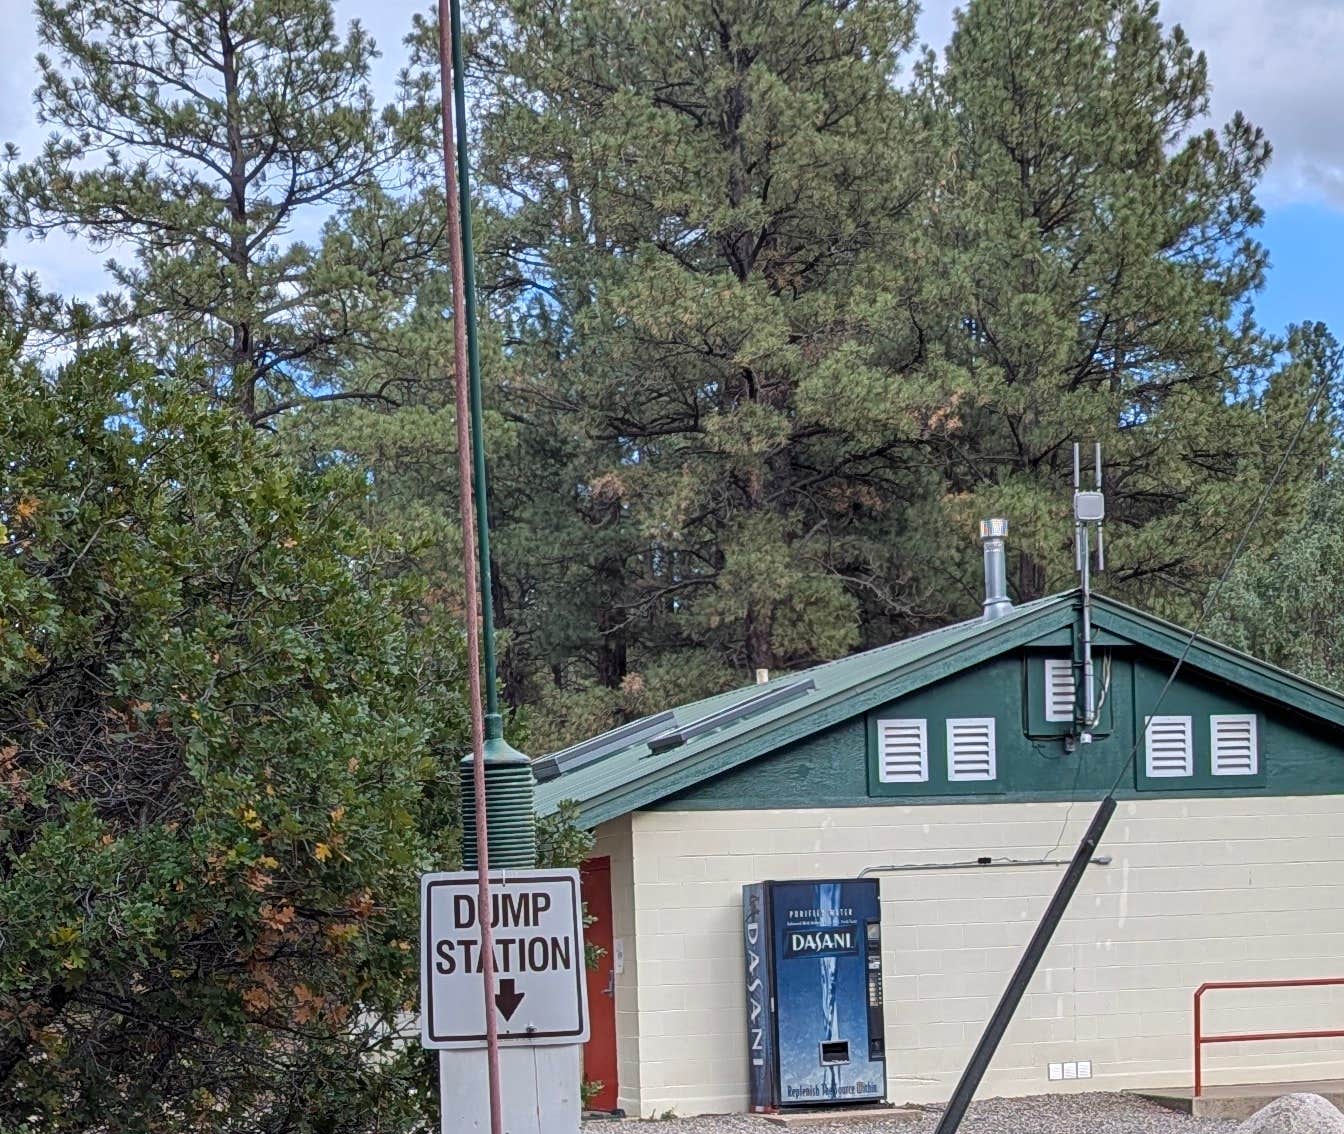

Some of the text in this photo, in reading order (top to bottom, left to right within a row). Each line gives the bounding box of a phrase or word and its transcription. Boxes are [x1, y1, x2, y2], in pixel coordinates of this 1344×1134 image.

[435, 936, 572, 975] STATION
[792, 931, 852, 953] DASANI
[747, 922, 764, 1066] DASANI
